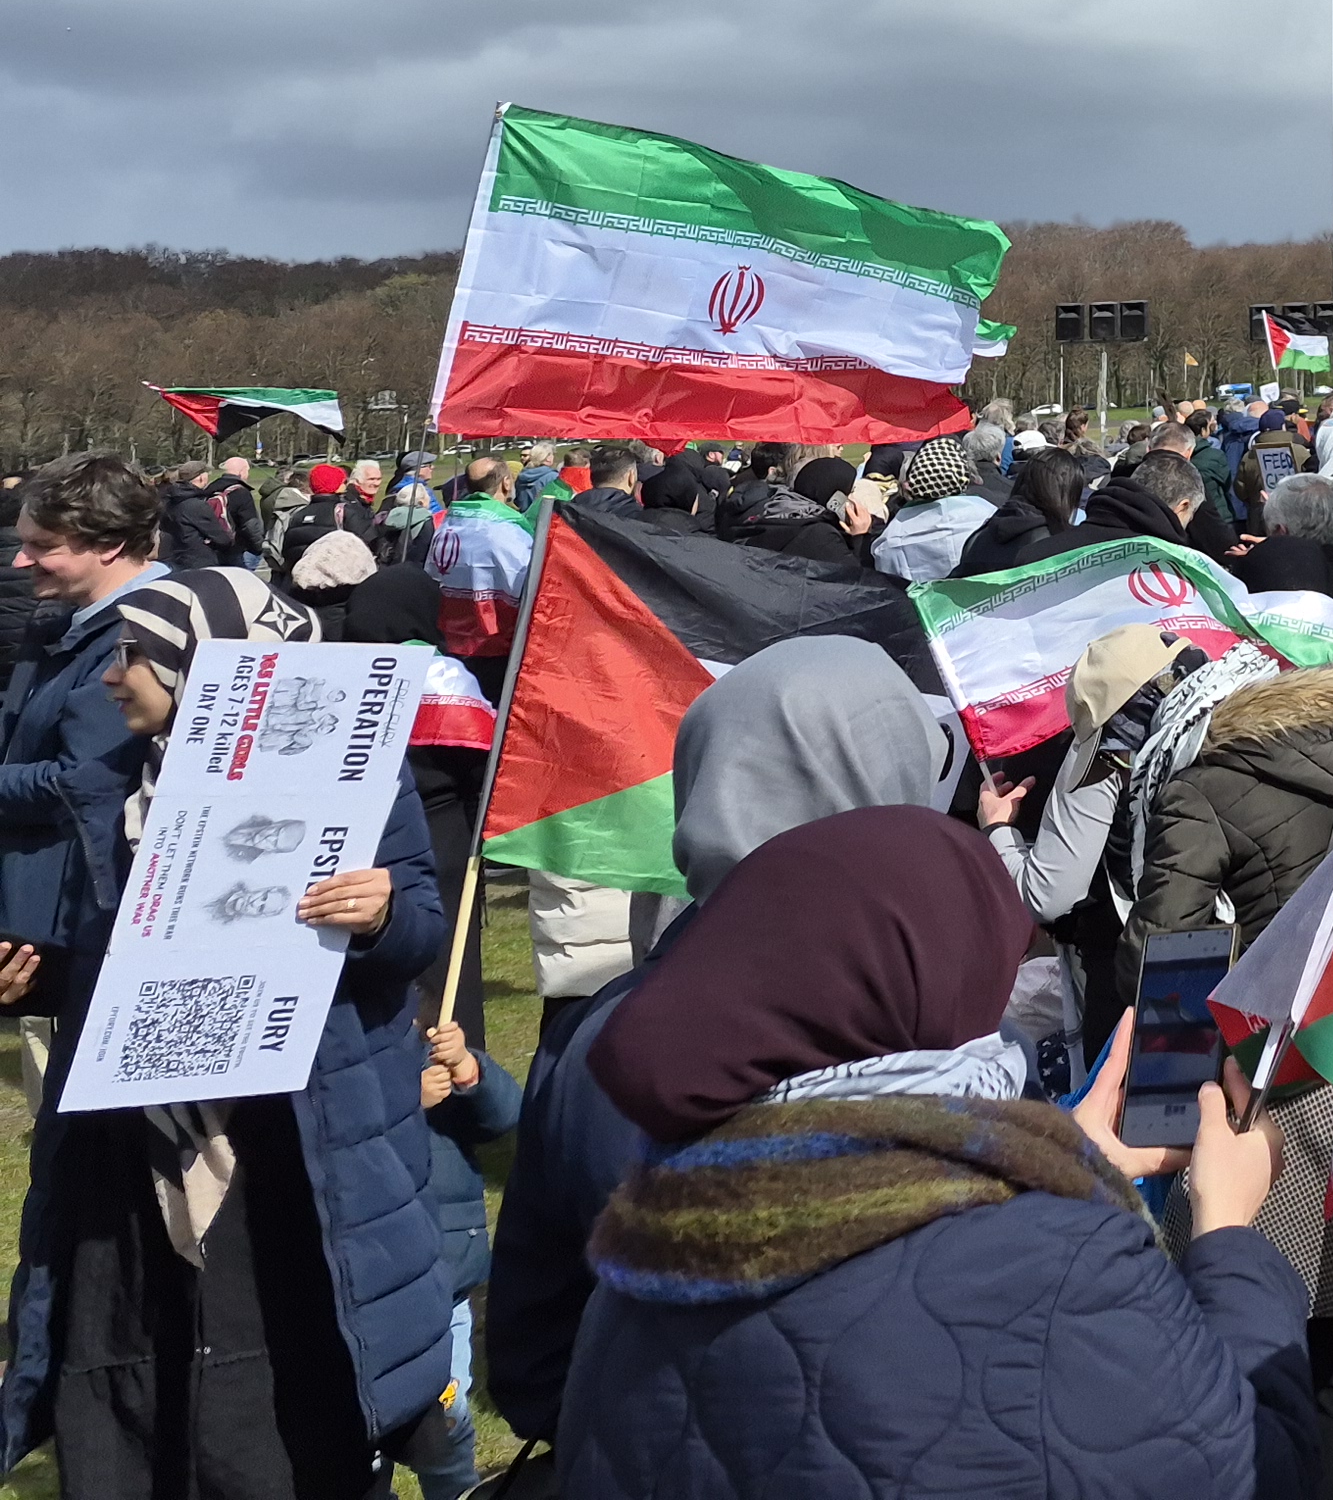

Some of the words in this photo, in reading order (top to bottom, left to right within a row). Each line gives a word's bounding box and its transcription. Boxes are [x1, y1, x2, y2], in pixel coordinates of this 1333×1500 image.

[1262, 452, 1293, 471] FEED
[230, 656, 256, 691] AGES
[196, 684, 219, 710] DAY
[241, 682, 269, 730] LITTLE
[220, 697, 244, 726] 7-12
[337, 657, 398, 781] OPERATION
[186, 717, 209, 743] ONE
[206, 733, 233, 772] killed
[226, 735, 254, 780] GIRLS
[154, 827, 168, 848] INTO
[164, 843, 177, 859] LET
[139, 853, 160, 898] ANOTHER
[155, 864, 171, 889] THEM
[131, 902, 146, 924] WAR
[145, 894, 162, 921] DRAG
[141, 925, 153, 936] US
[257, 996, 298, 1052] FURY
